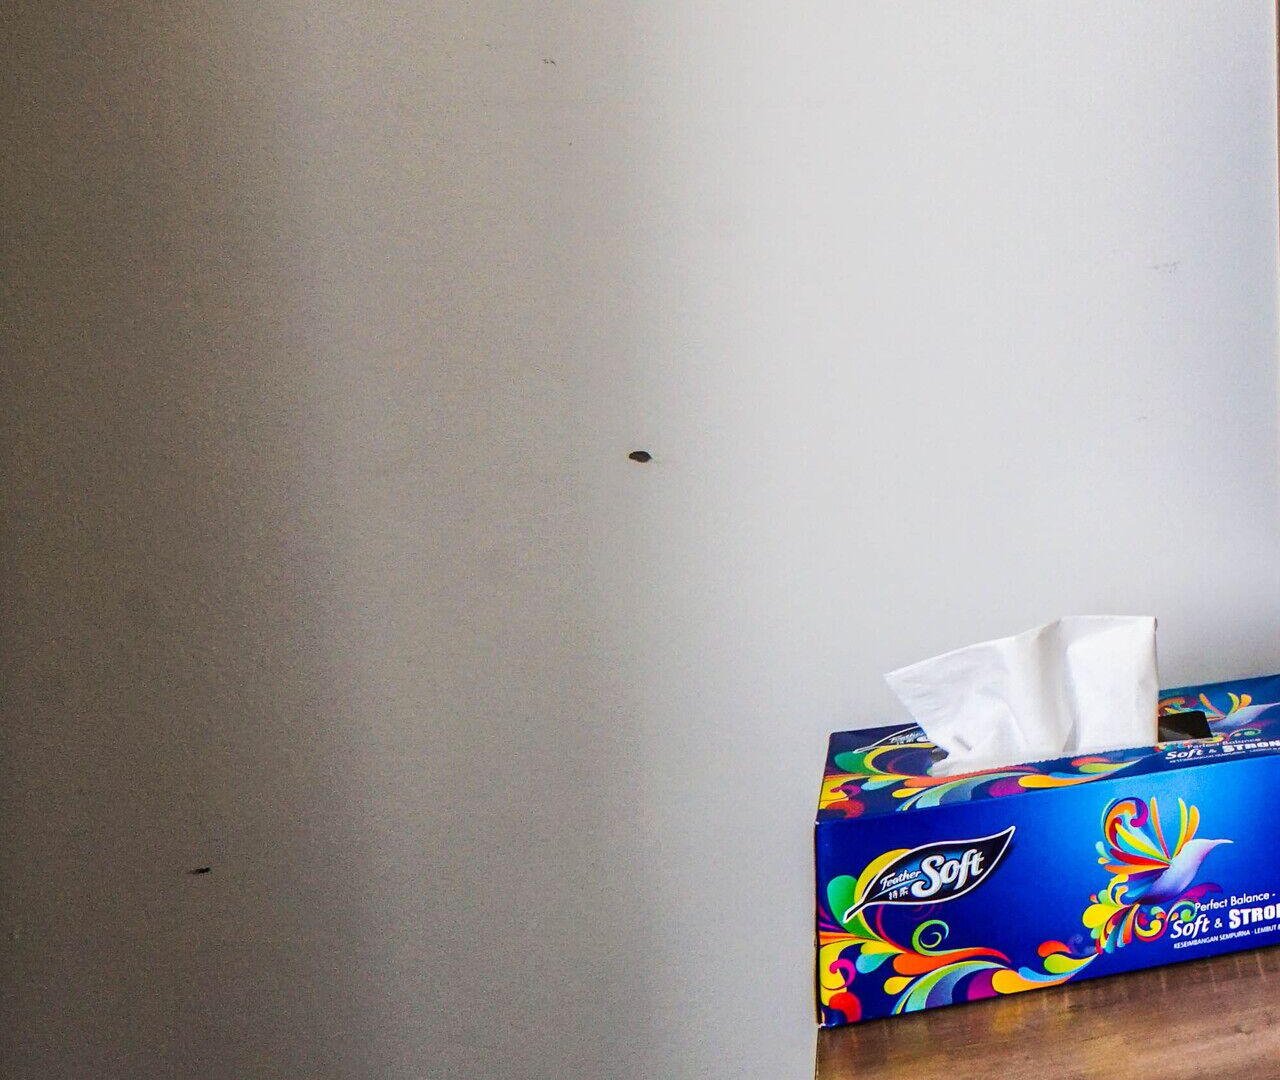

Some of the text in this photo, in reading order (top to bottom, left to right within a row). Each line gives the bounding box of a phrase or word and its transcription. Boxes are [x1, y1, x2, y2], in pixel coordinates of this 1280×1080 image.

[1165, 748, 1205, 761] Soft
[880, 869, 922, 891] Feather
[911, 848, 985, 898] Soft
[1194, 899, 1229, 913] Perfect
[1230, 892, 1270, 907] Balance
[1170, 913, 1211, 939] Soft
[1214, 917, 1223, 929] &
